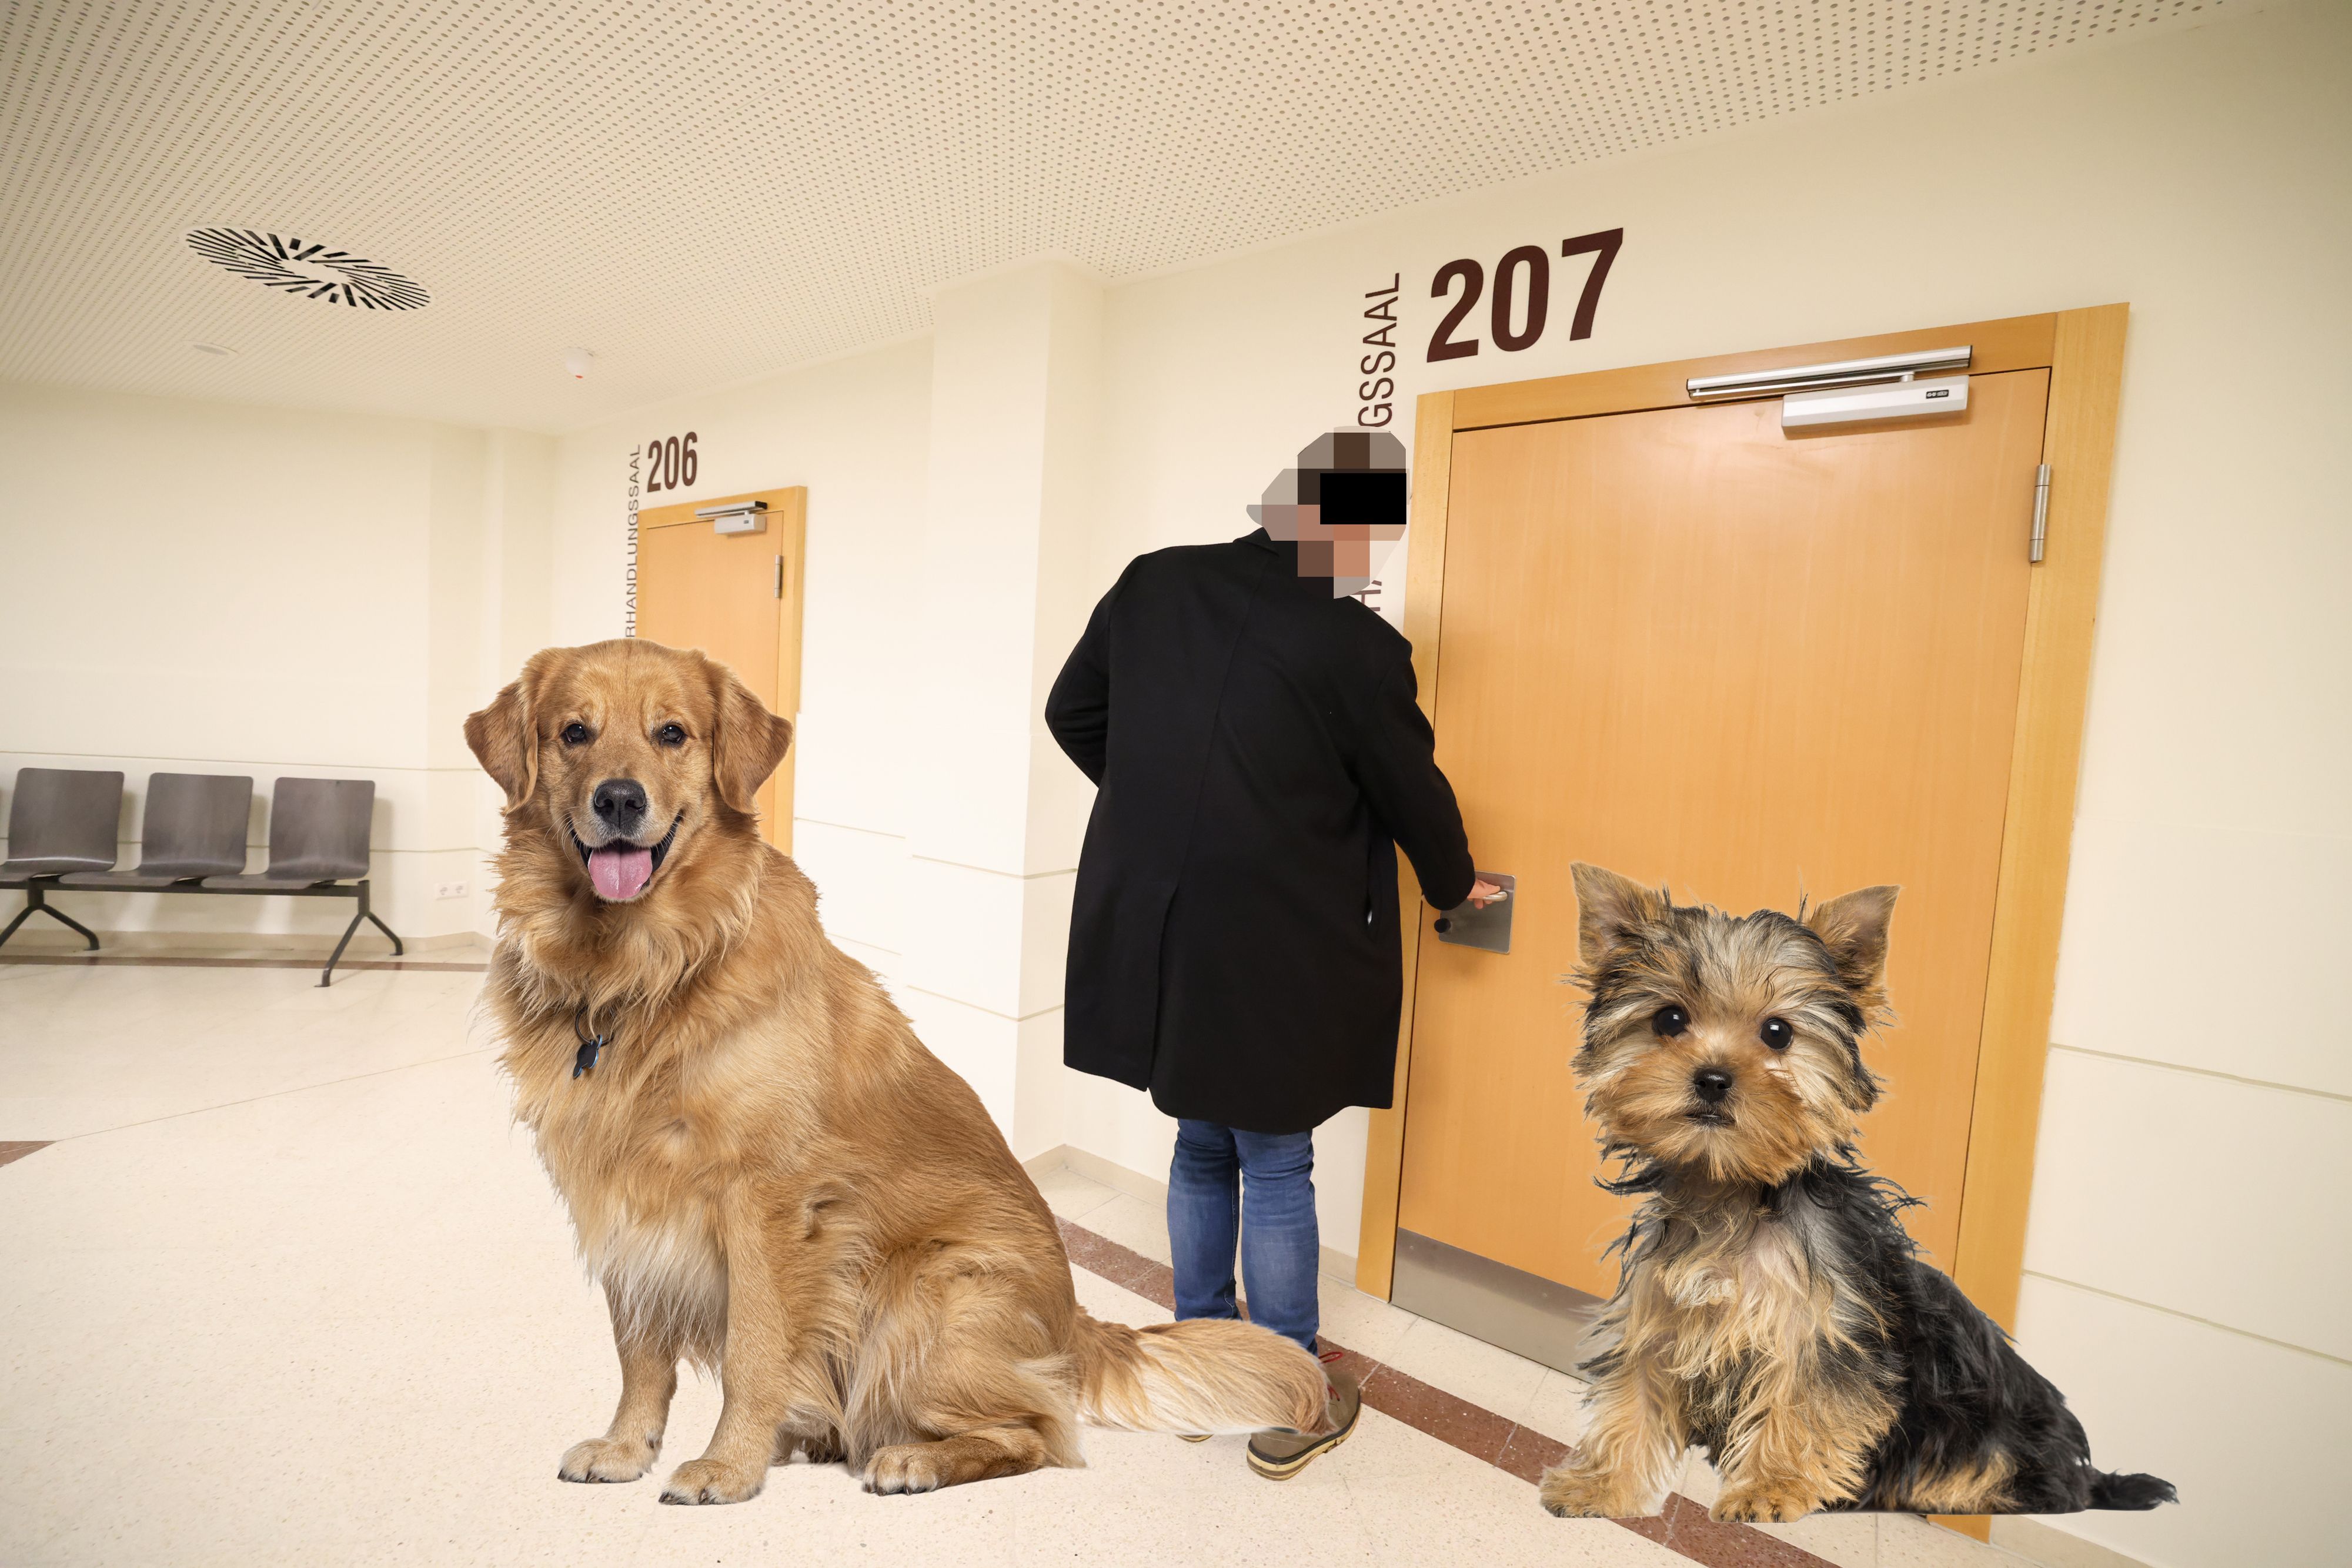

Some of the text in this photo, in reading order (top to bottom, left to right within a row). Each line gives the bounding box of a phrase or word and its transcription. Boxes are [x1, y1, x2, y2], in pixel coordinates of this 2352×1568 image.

[1357, 272, 1399, 427] GSSAAL
[1426, 227, 1623, 363] 207
[647, 431, 698, 493] 206
[625, 444, 640, 637] RHANDLUNGSSAAL
